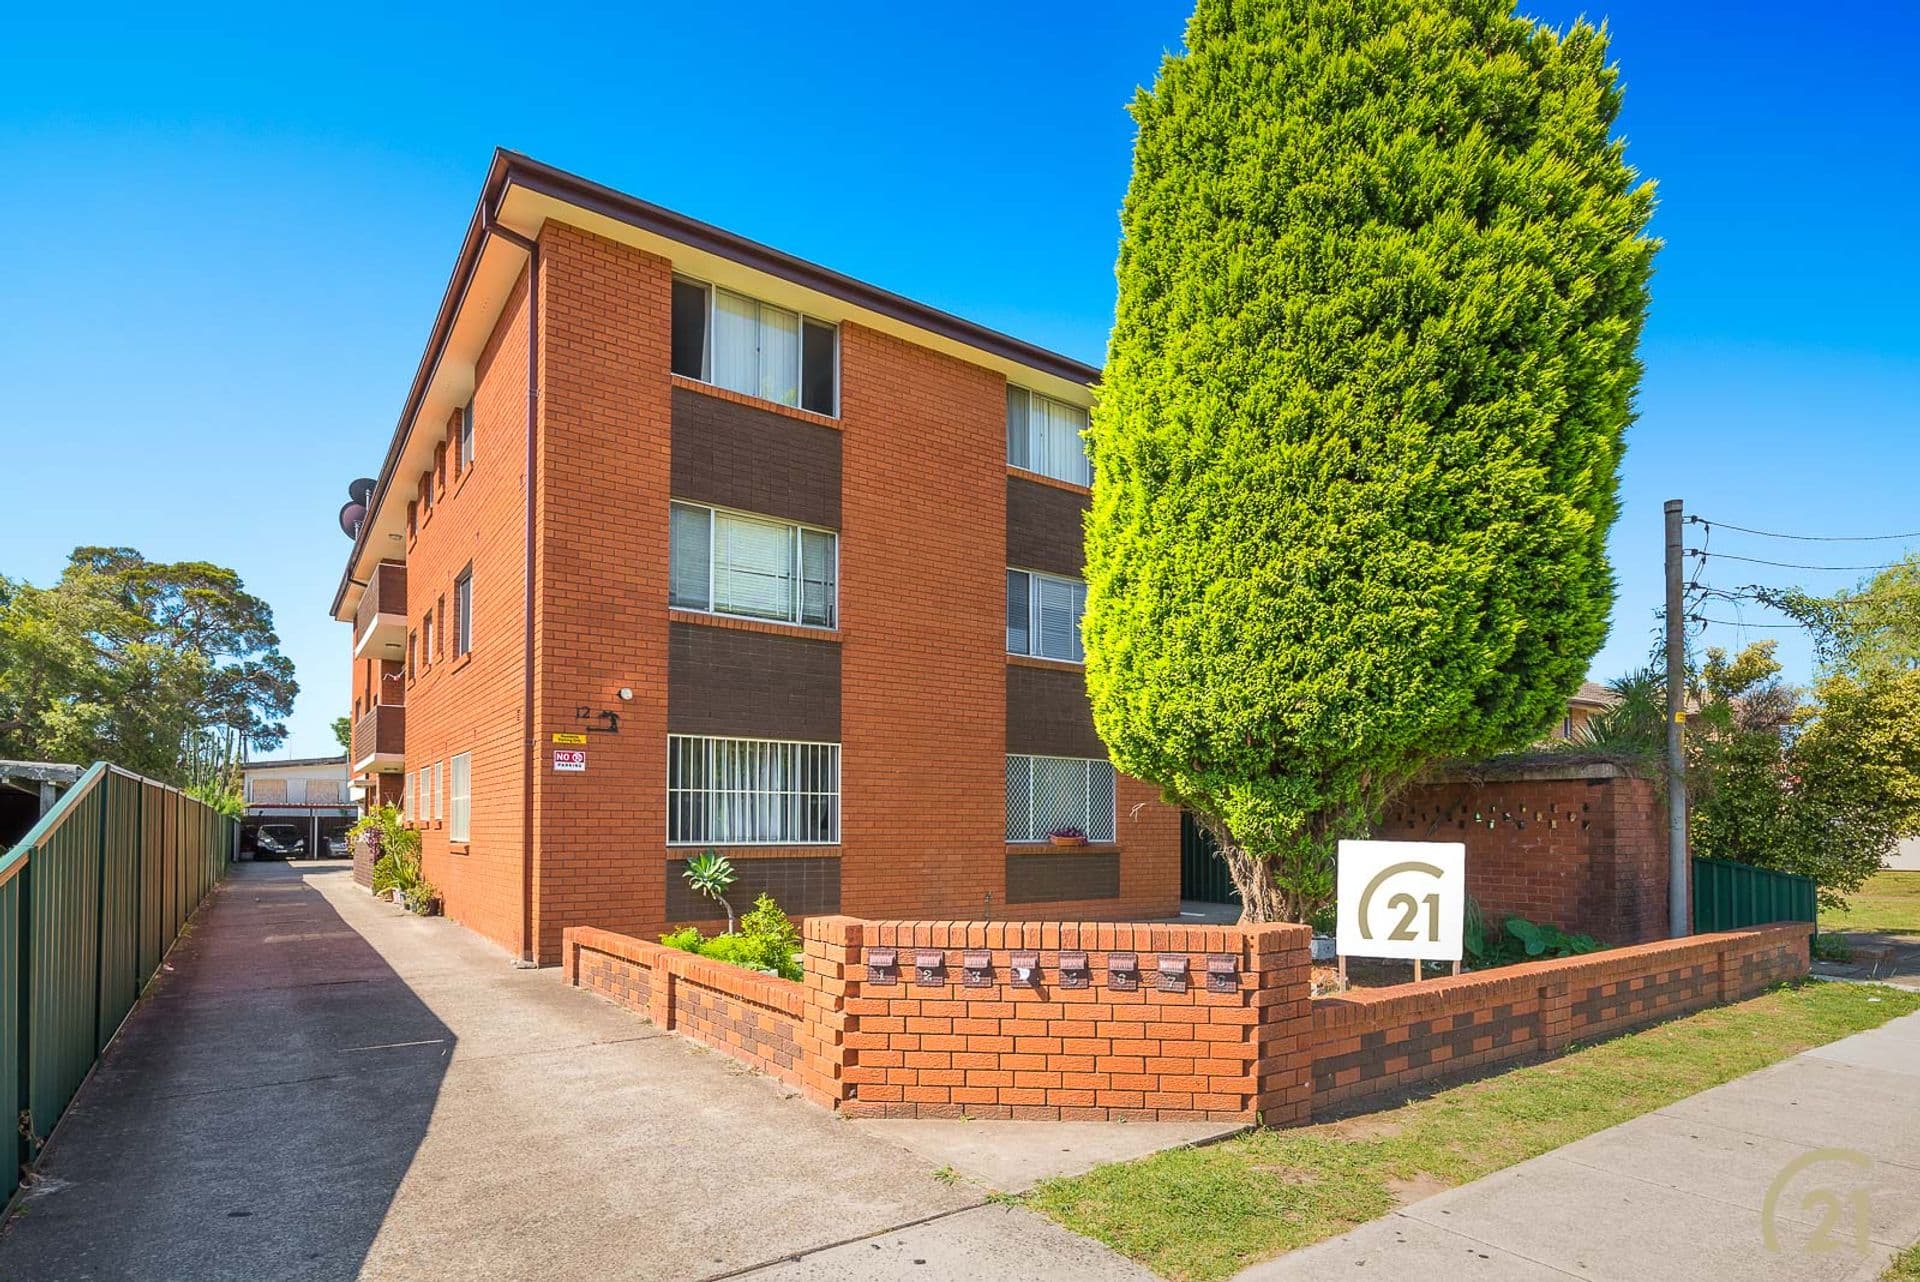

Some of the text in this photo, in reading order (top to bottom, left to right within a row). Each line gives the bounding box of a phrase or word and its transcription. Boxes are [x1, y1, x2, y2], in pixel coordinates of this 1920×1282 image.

[576, 706, 591, 719] 12
[556, 753, 570, 761] NO
[878, 969, 885, 981] 1
[923, 970, 932, 981] 2
[972, 971, 981, 983] 3
[1167, 976, 1177, 988] 7
